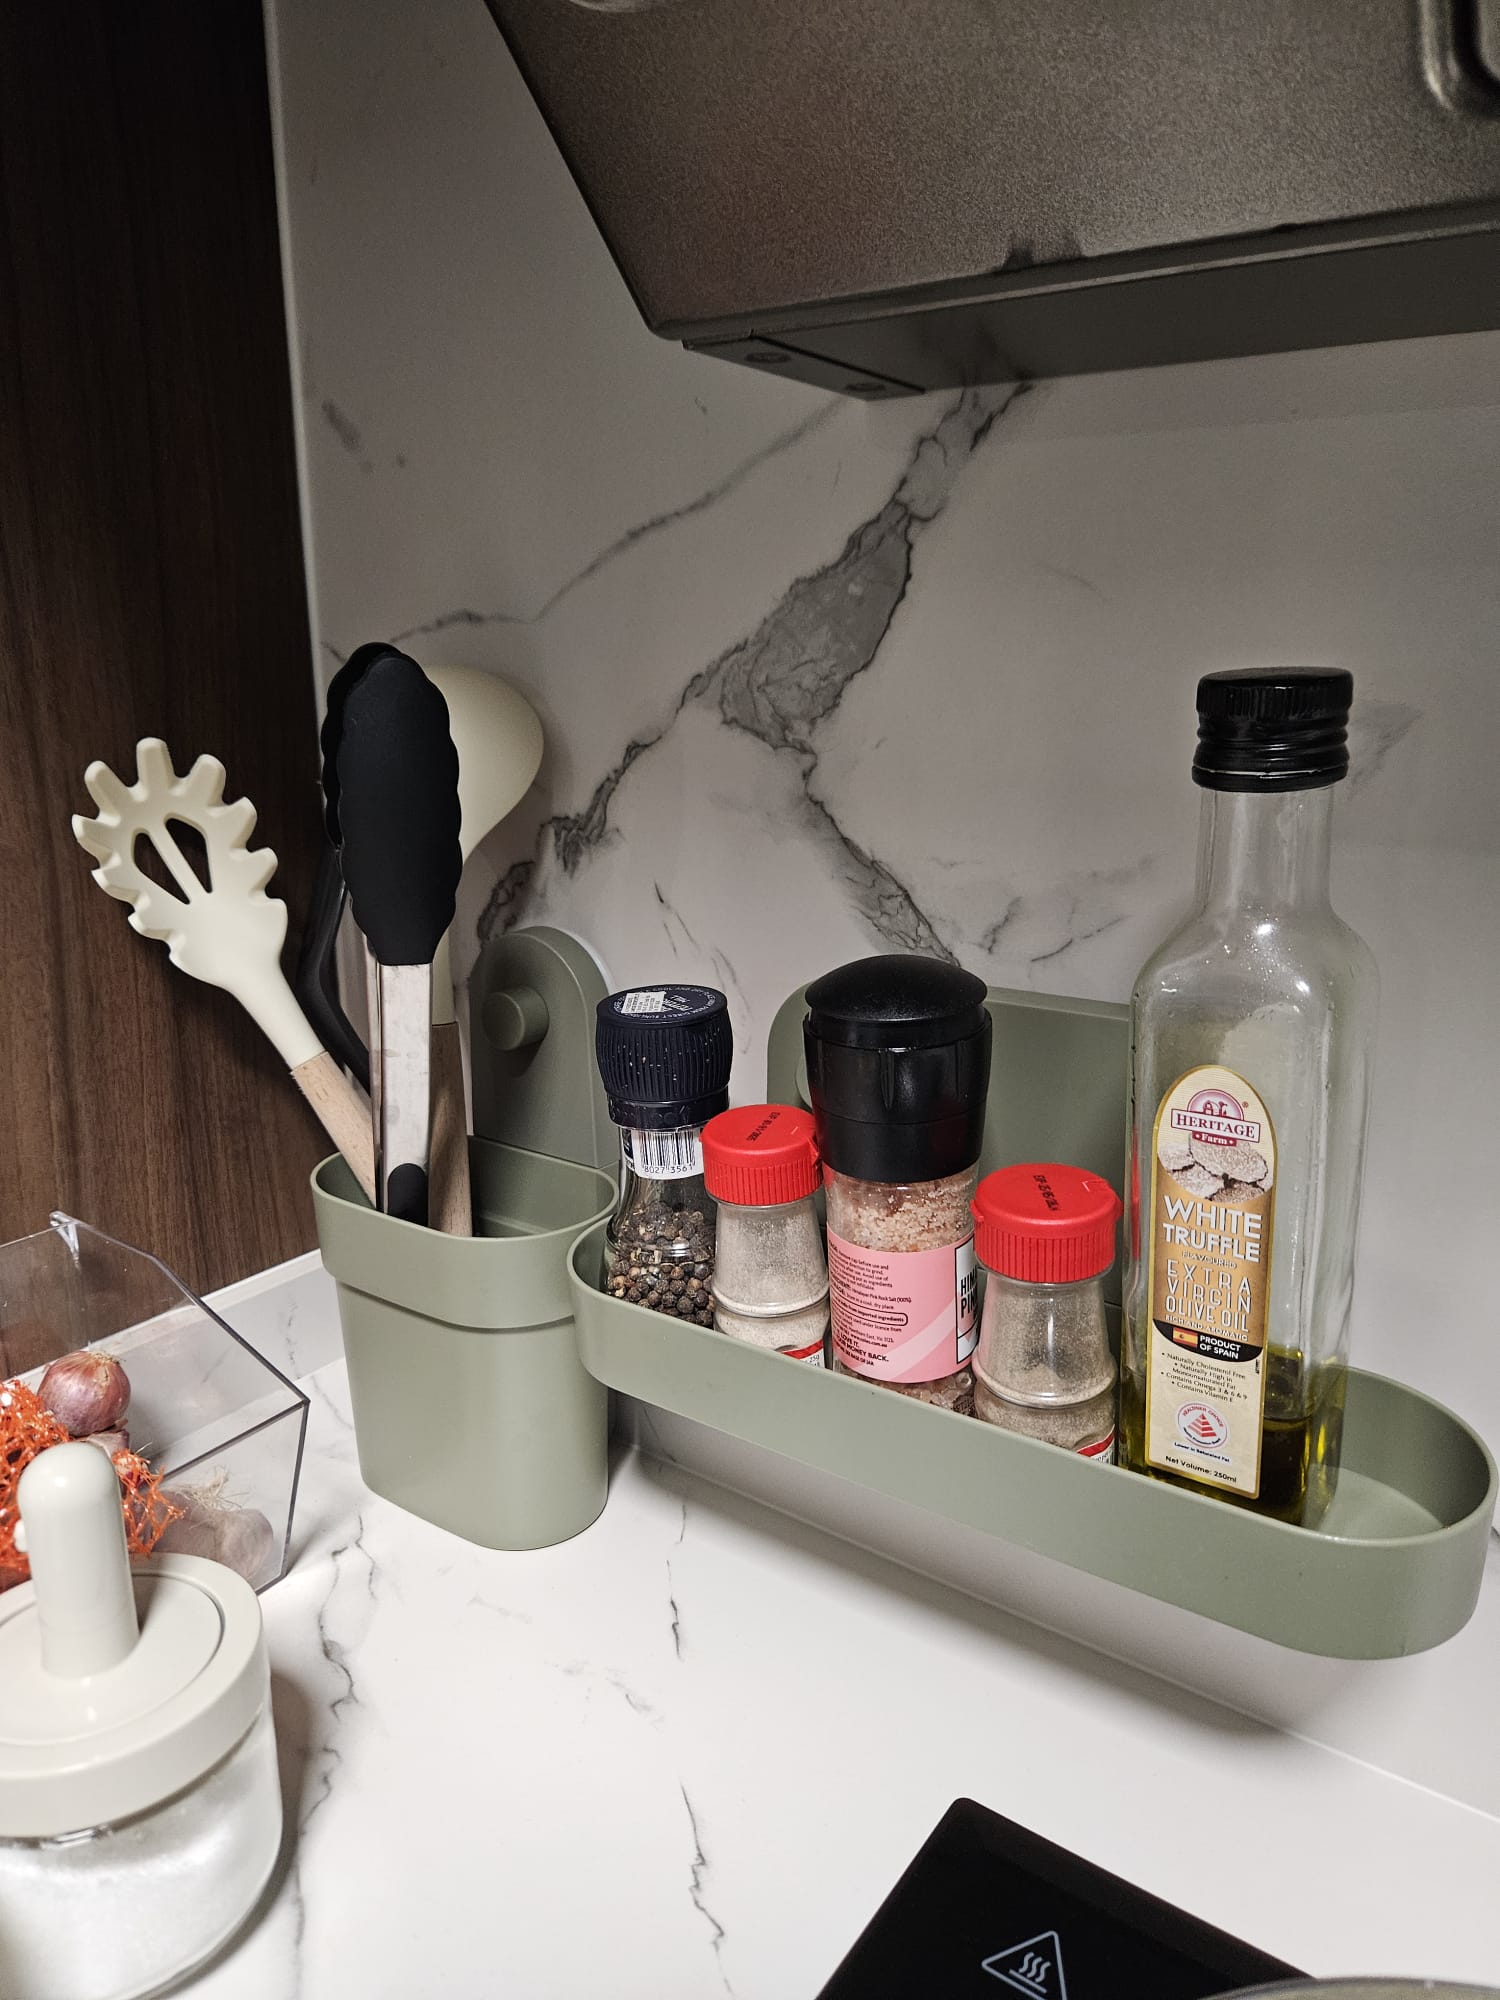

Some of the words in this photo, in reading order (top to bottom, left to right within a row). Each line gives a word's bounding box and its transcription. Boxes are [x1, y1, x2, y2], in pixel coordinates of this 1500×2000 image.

[1176, 1113, 1254, 1138] HERITAGE
[1201, 1134, 1227, 1144] Farm
[1164, 1195, 1262, 1239] WHITE
[1163, 1222, 1260, 1263] TRUFFLE
[1167, 1259, 1250, 1296] EXTRA
[1168, 1277, 1251, 1314] VIRGIN
[1166, 1295, 1216, 1323] OLIVE
[1222, 1310, 1249, 1332] OIL
[1206, 1325, 1248, 1341] AROMATIC
[847, 1343, 867, 1356] MONEY
[868, 1352, 889, 1361] BACK.
[1200, 1335, 1241, 1351] PRODUCT
[1167, 1353, 1194, 1366] Naturally
[1214, 1347, 1239, 1359] SPAIN
[1180, 1364, 1207, 1376] Naturally
[1210, 1371, 1224, 1380] High
[1166, 1373, 1192, 1384] Contains
[1194, 1380, 1216, 1391] Omega
[1177, 1382, 1203, 1393] Contains
[1205, 1390, 1228, 1401] Vitamin
[1165, 1456, 1179, 1464] Net
[1181, 1460, 1211, 1474] Volume:
[1214, 1471, 1237, 1482] 250ml
